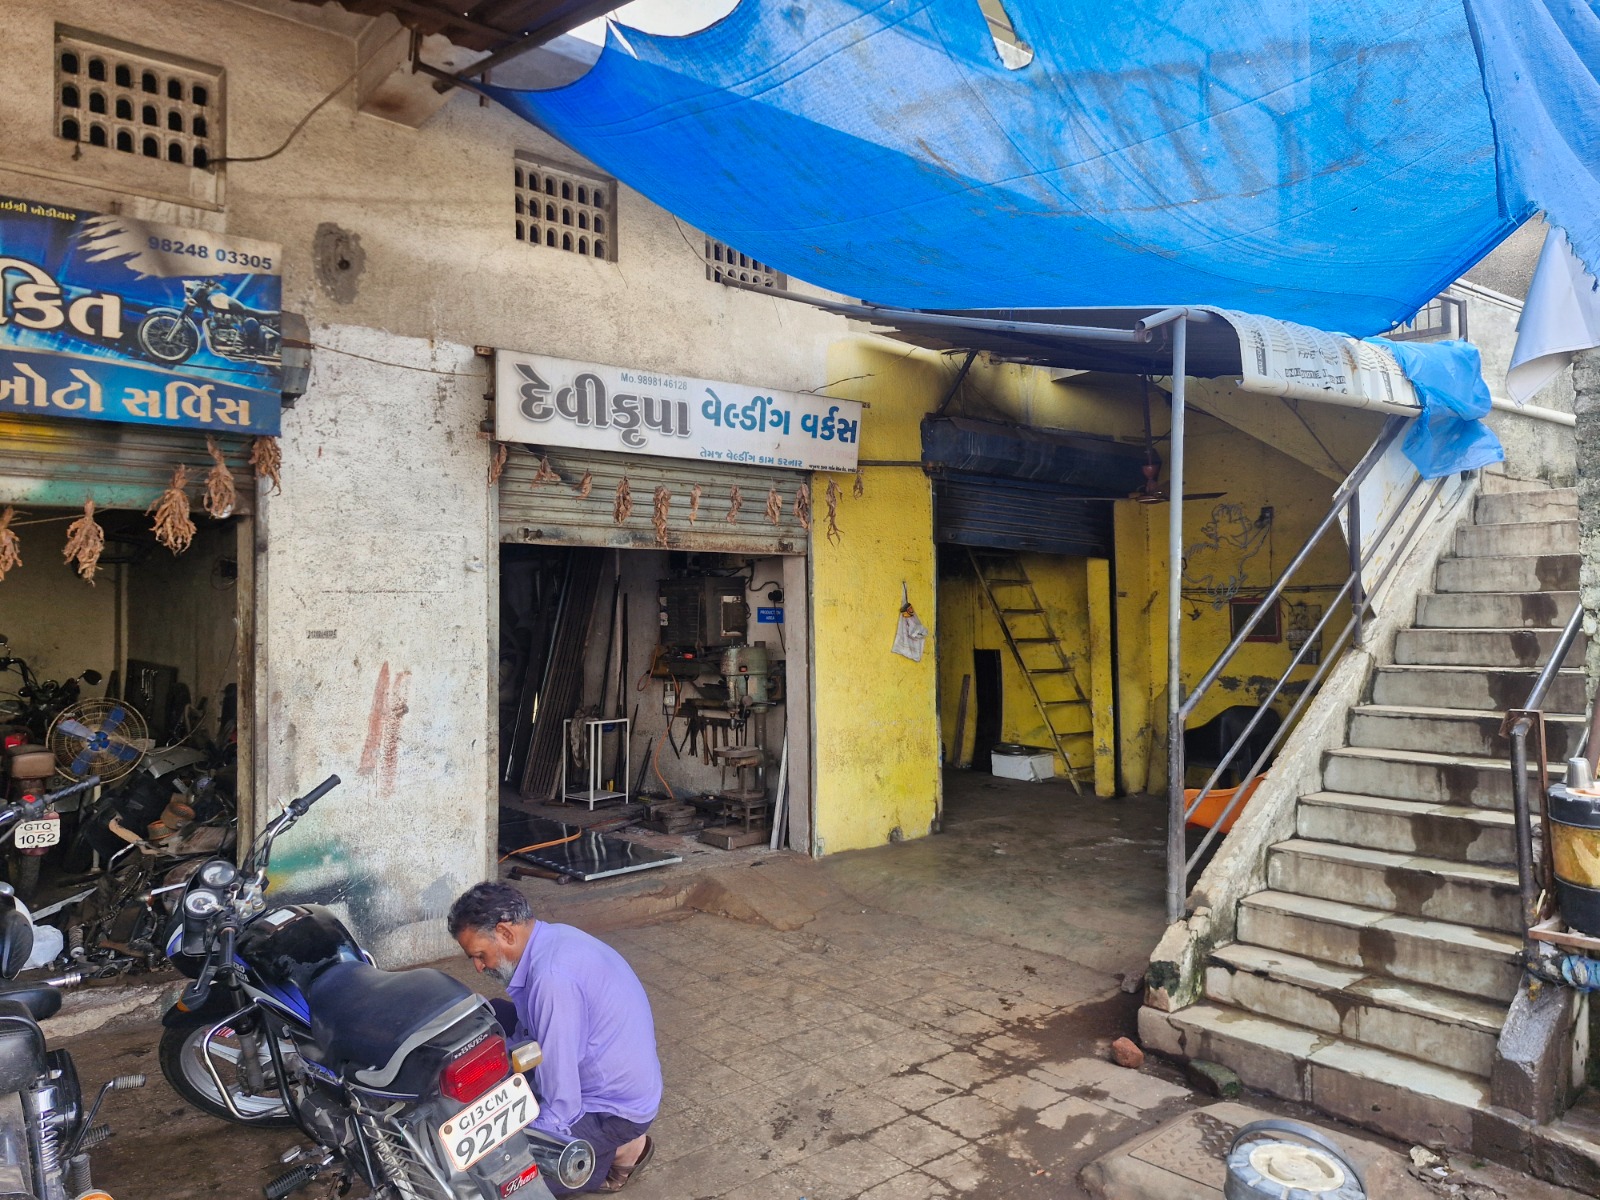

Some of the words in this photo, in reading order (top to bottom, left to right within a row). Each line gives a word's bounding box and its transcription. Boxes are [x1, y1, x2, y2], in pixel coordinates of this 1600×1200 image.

[148, 236, 208, 258] 98248
[215, 248, 272, 270] 03305
[621, 372, 636, 383] Mo.
[637, 374, 688, 391] 9898146128
[701, 387, 791, 435] વેલ્ડીંગ
[19, 833, 56, 845] 1052
[456, 1095, 527, 1165] 9277
